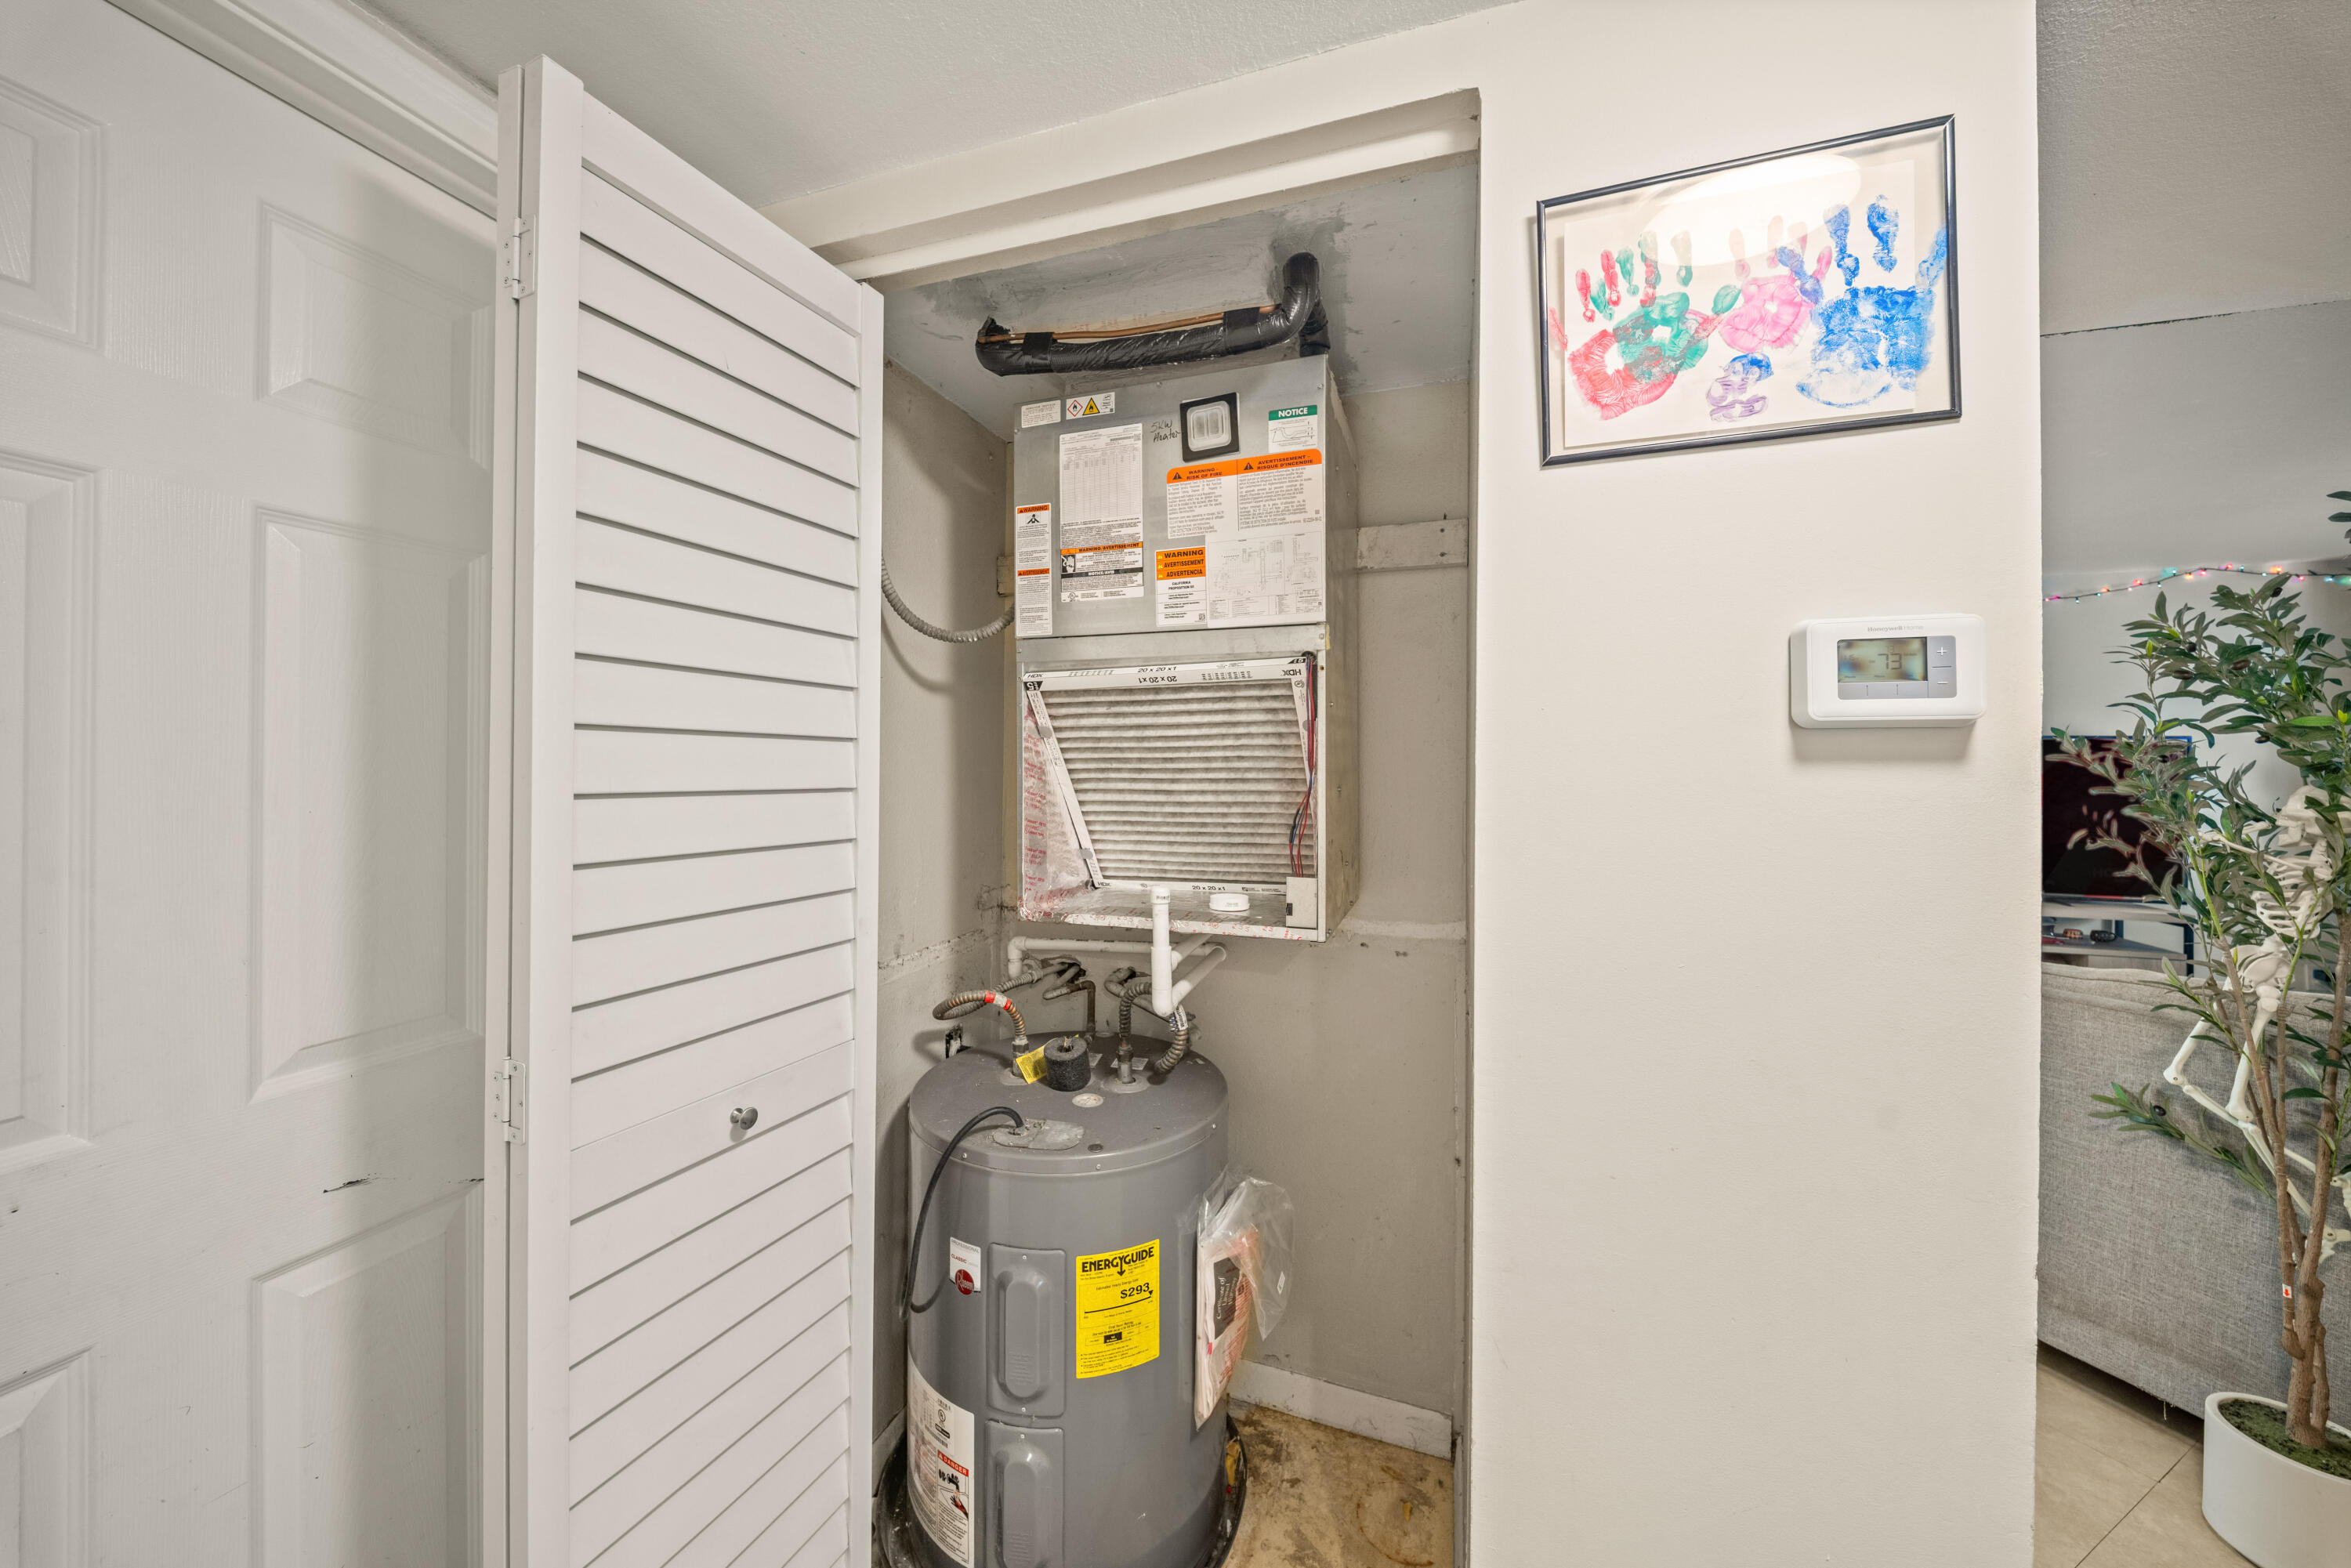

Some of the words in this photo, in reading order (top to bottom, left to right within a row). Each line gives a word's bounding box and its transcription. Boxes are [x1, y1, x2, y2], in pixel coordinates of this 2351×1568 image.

[1278, 407, 1308, 418] NOTICE
[1153, 428, 1181, 444] Heater
[1258, 454, 1306, 465] AVERTISSEMENT
[1280, 459, 1313, 468] D'INCENDIE
[1164, 549, 1204, 559] WARNING
[1164, 559, 1204, 568] AVERTISSEMENT
[1166, 568, 1203, 578] ADVERTENCIA
[1867, 625, 1903, 633] Honeywell
[1878, 653, 1902, 670] 73
[951, 1239, 980, 1254] PROFESSIONAL
[951, 1253, 967, 1264] CLASSIC
[1081, 1246, 1155, 1275] ENERGYGUIDE
[1218, 1276, 1226, 1285] of
[944, 1455, 968, 1476] DANGER
